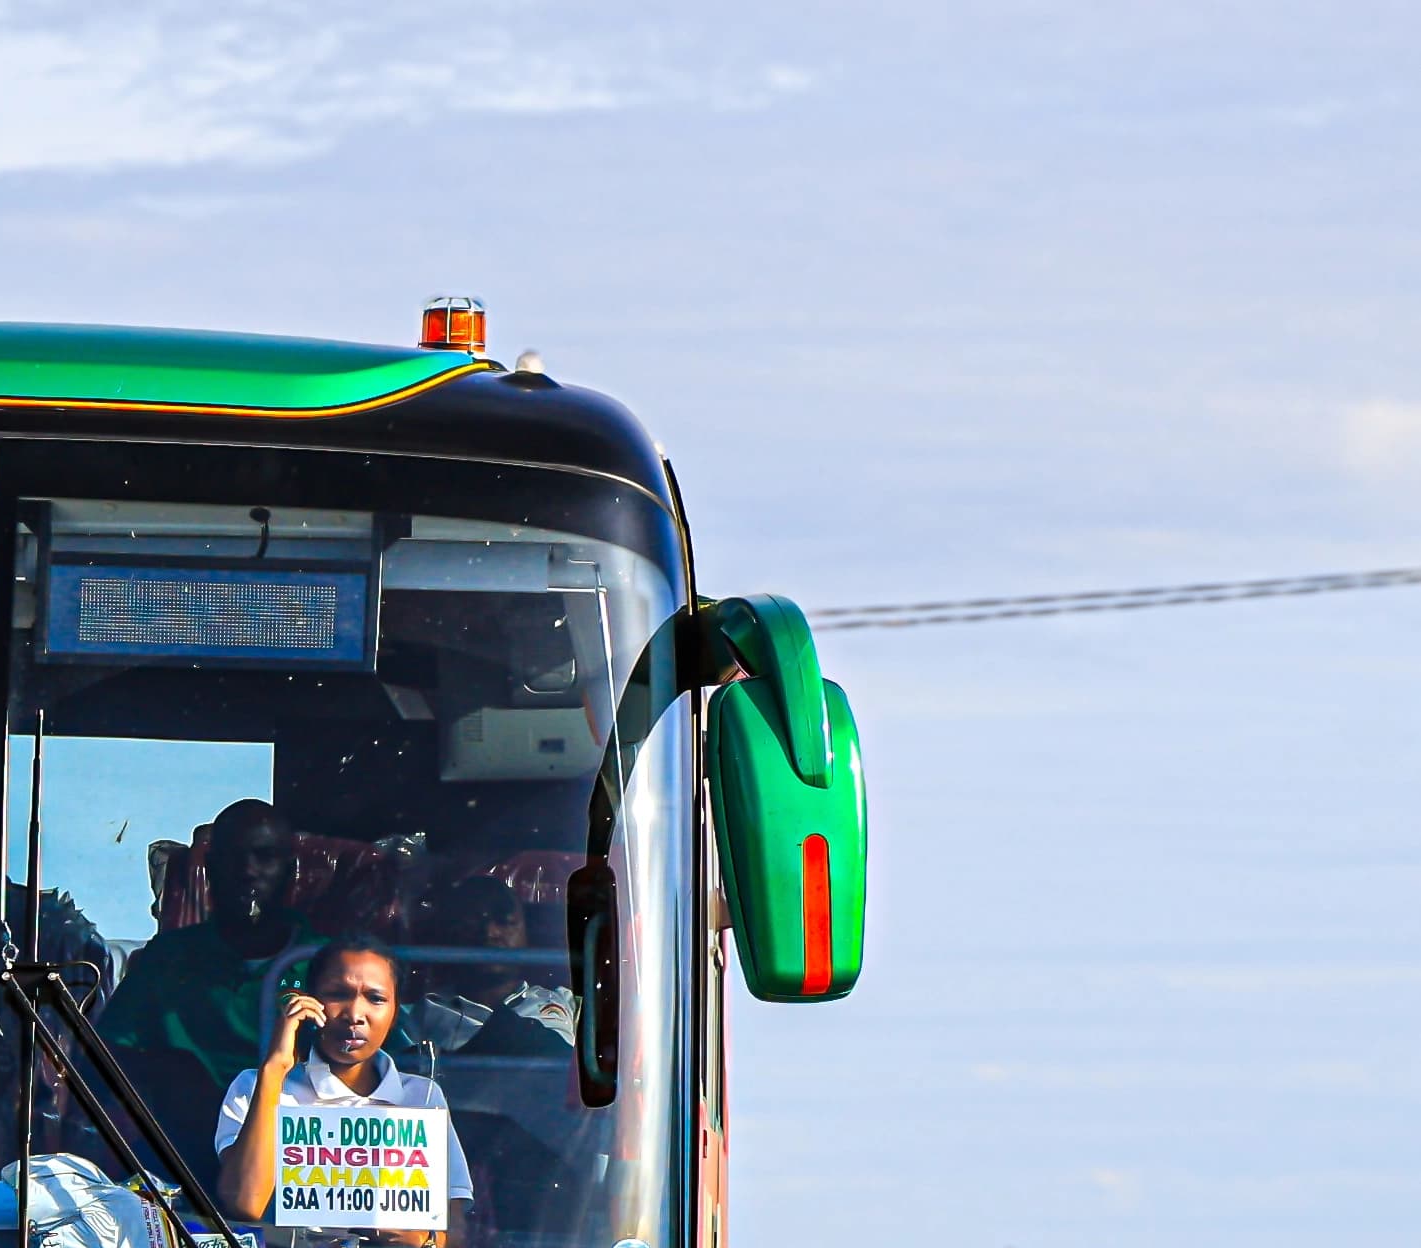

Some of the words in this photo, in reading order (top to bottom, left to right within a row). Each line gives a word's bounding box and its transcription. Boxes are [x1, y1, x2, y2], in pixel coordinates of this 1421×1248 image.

[282, 1116, 322, 1146] DAR
[340, 1117, 428, 1148] DODOMA
[282, 1146, 430, 1167] SINGIDA
[282, 1166, 429, 1188] KAHAMA
[282, 1187, 320, 1210] SAA
[325, 1188, 375, 1212] 11:00
[379, 1189, 430, 1213] JIONI
